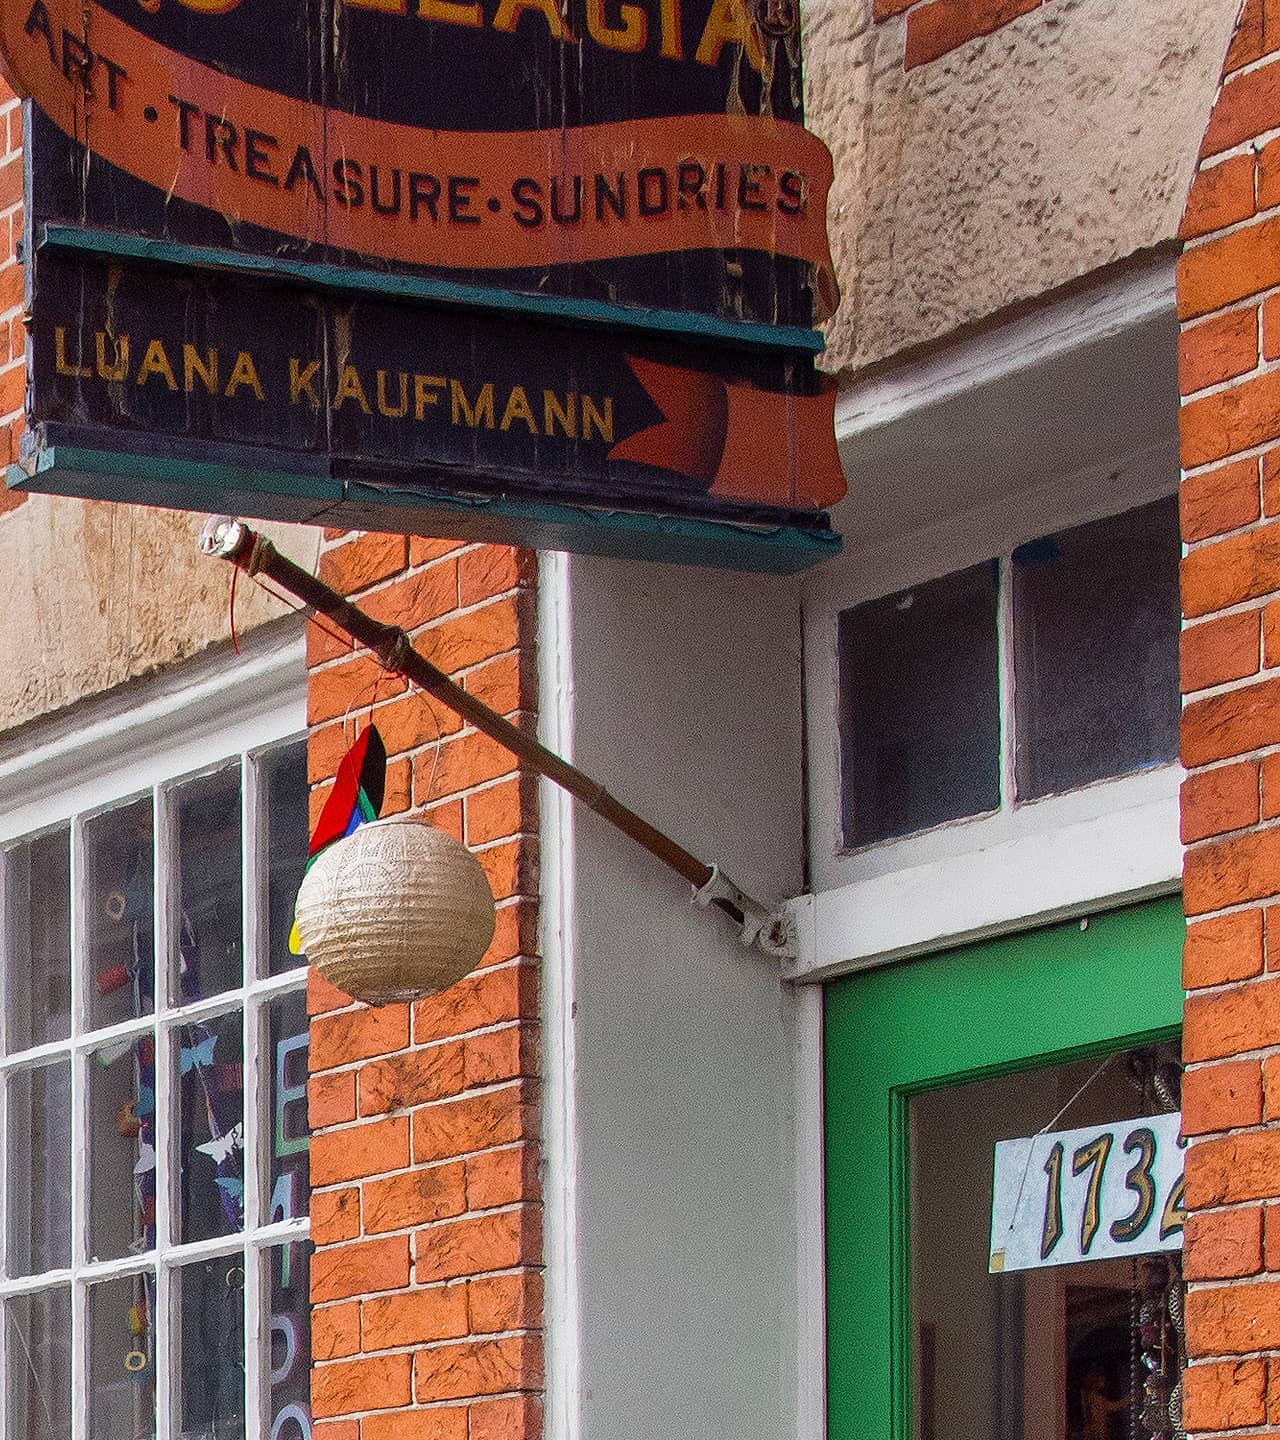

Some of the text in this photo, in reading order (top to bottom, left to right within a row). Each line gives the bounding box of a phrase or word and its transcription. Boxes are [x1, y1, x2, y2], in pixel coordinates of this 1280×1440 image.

[168, 98, 482, 225] TREASURE
[511, 162, 807, 228] SUNDRIES
[54, 324, 615, 444] LUANA KAUFMANN
